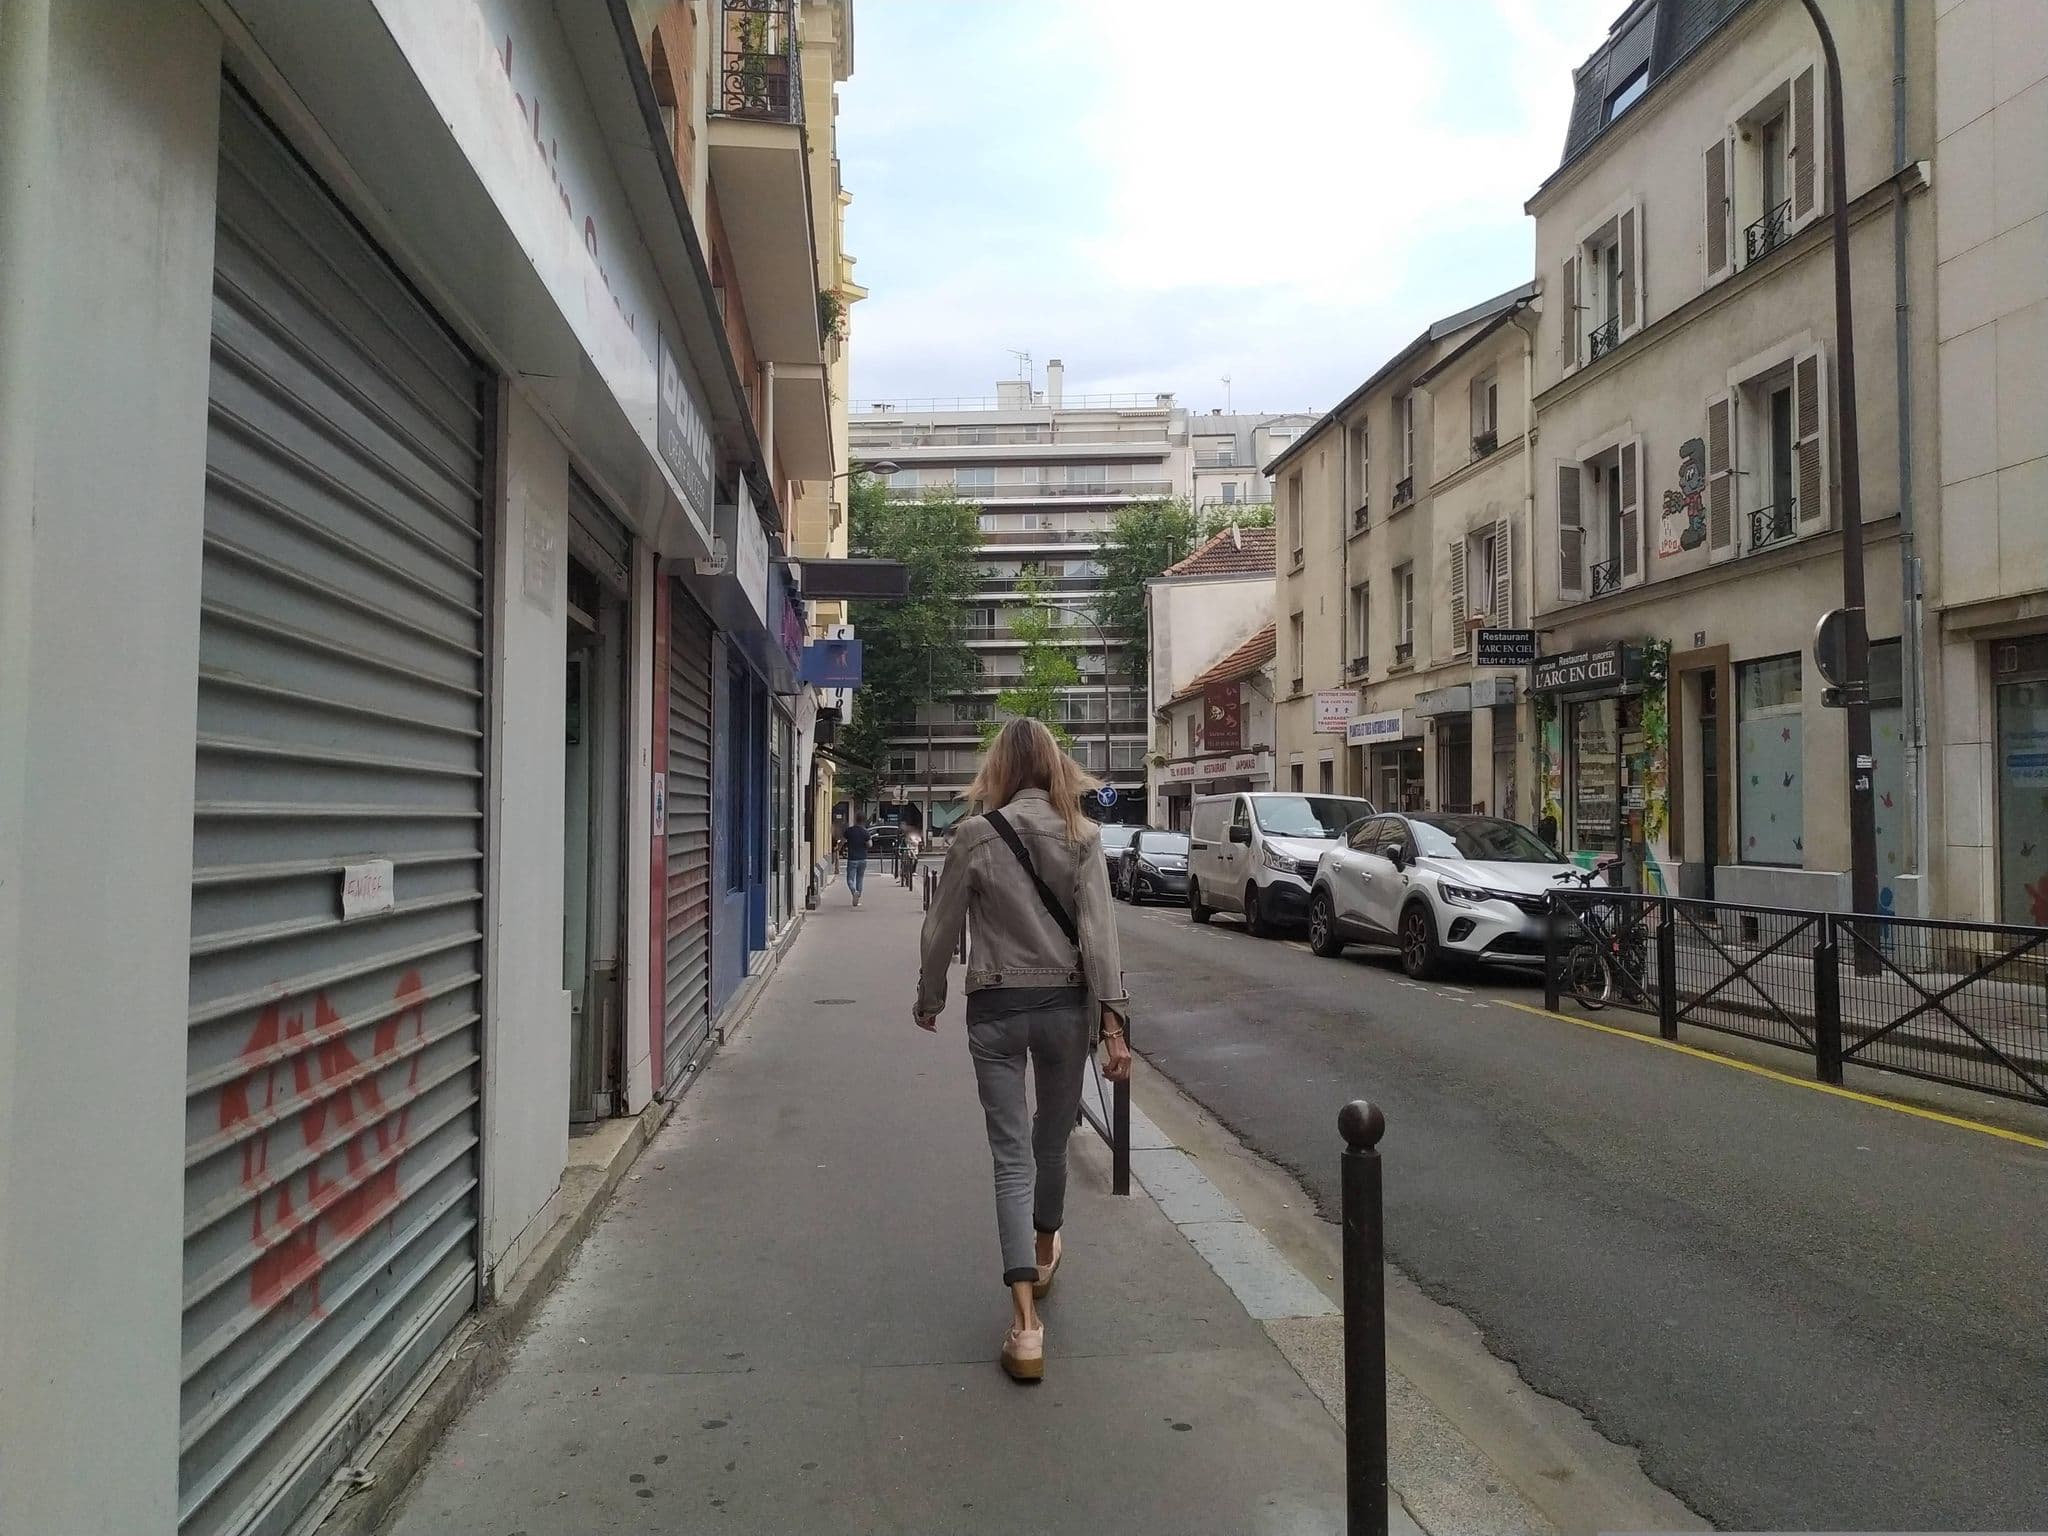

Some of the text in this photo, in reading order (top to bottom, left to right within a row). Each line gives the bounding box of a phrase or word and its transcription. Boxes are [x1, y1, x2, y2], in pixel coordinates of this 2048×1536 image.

[663, 349, 711, 481] DONIC
[1482, 632, 1529, 641] Restaurant
[1478, 644, 1533, 653] L'ARC EN CIEL
[1558, 653, 1588, 666] Restaurant
[1535, 660, 1616, 689] L'ARC EN CIEL
[1203, 762, 1227, 774] RESTAURANT
[1235, 759, 1256, 770] JAPONAIS
